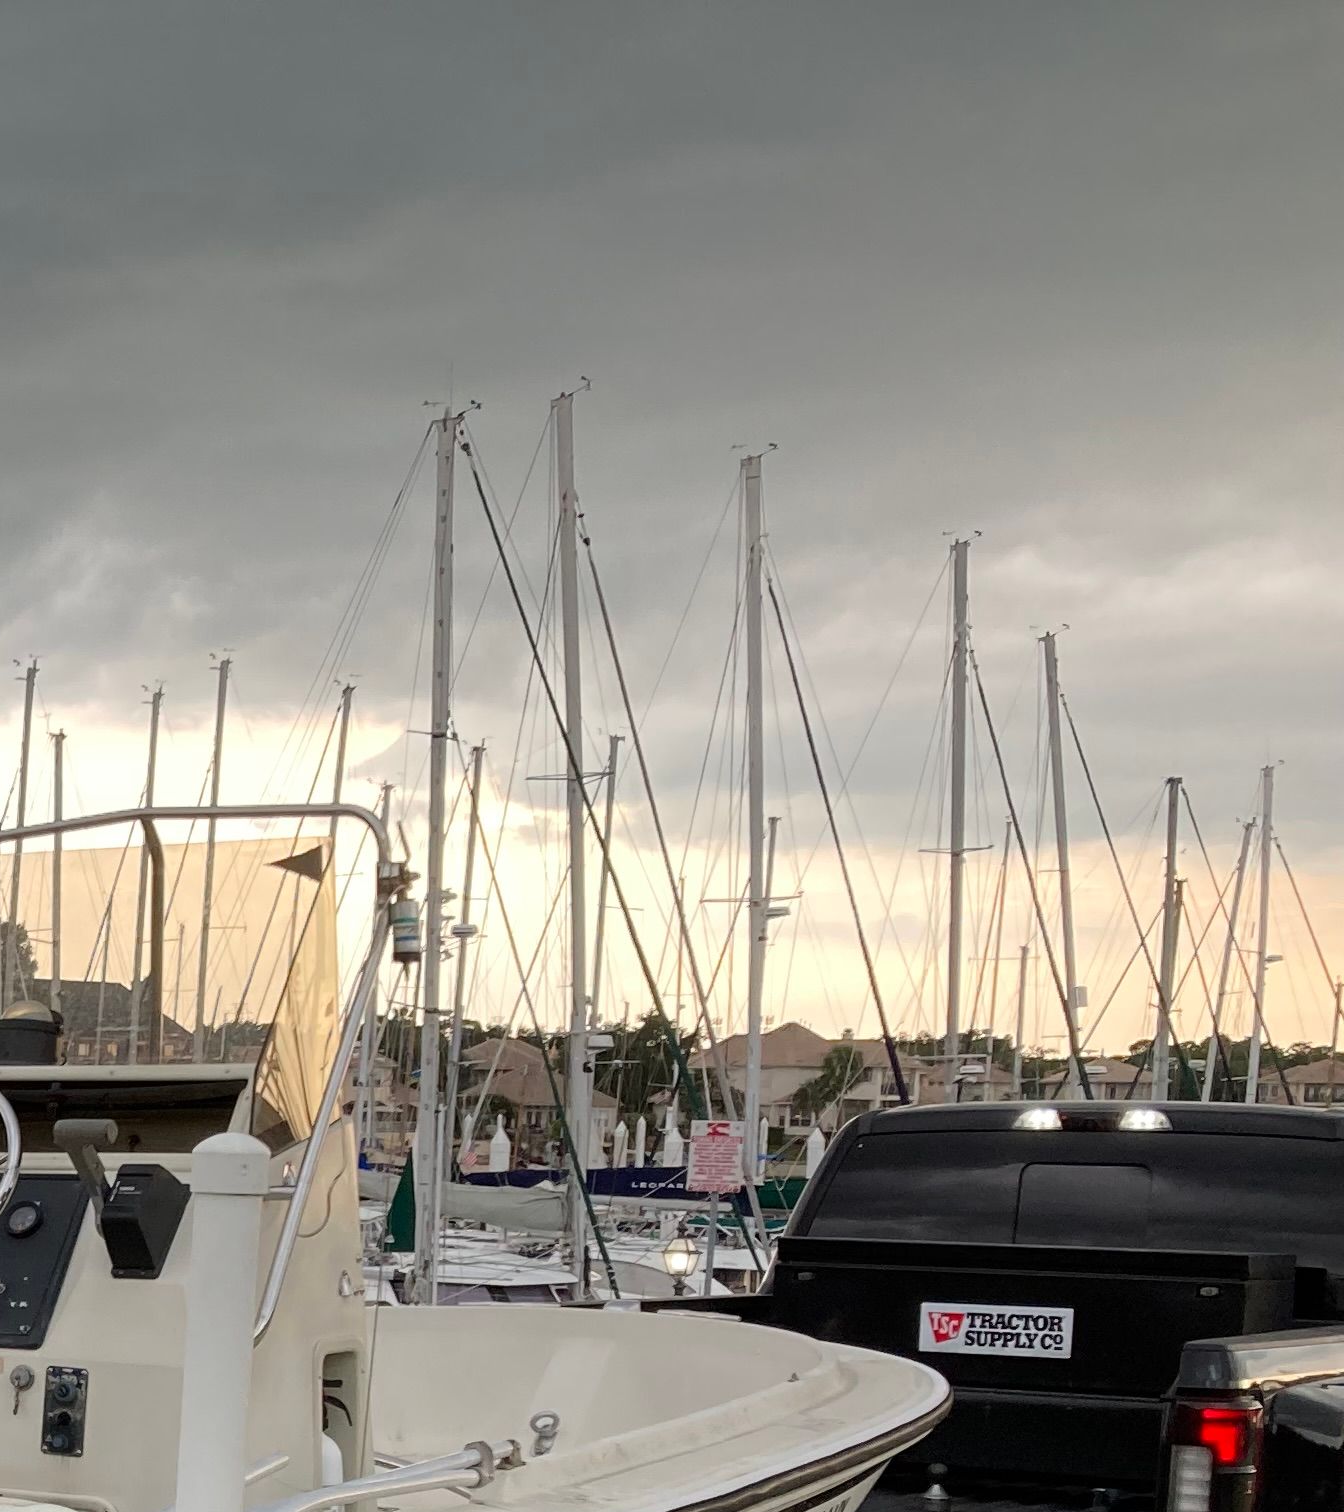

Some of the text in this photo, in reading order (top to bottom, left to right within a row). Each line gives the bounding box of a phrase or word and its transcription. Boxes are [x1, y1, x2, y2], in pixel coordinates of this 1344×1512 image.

[632, 1181, 685, 1189] LEOPAR
[931, 1312, 960, 1338] TSC
[966, 1312, 1064, 1332] TRACTOR
[964, 1330, 1039, 1349] SUPPLY
